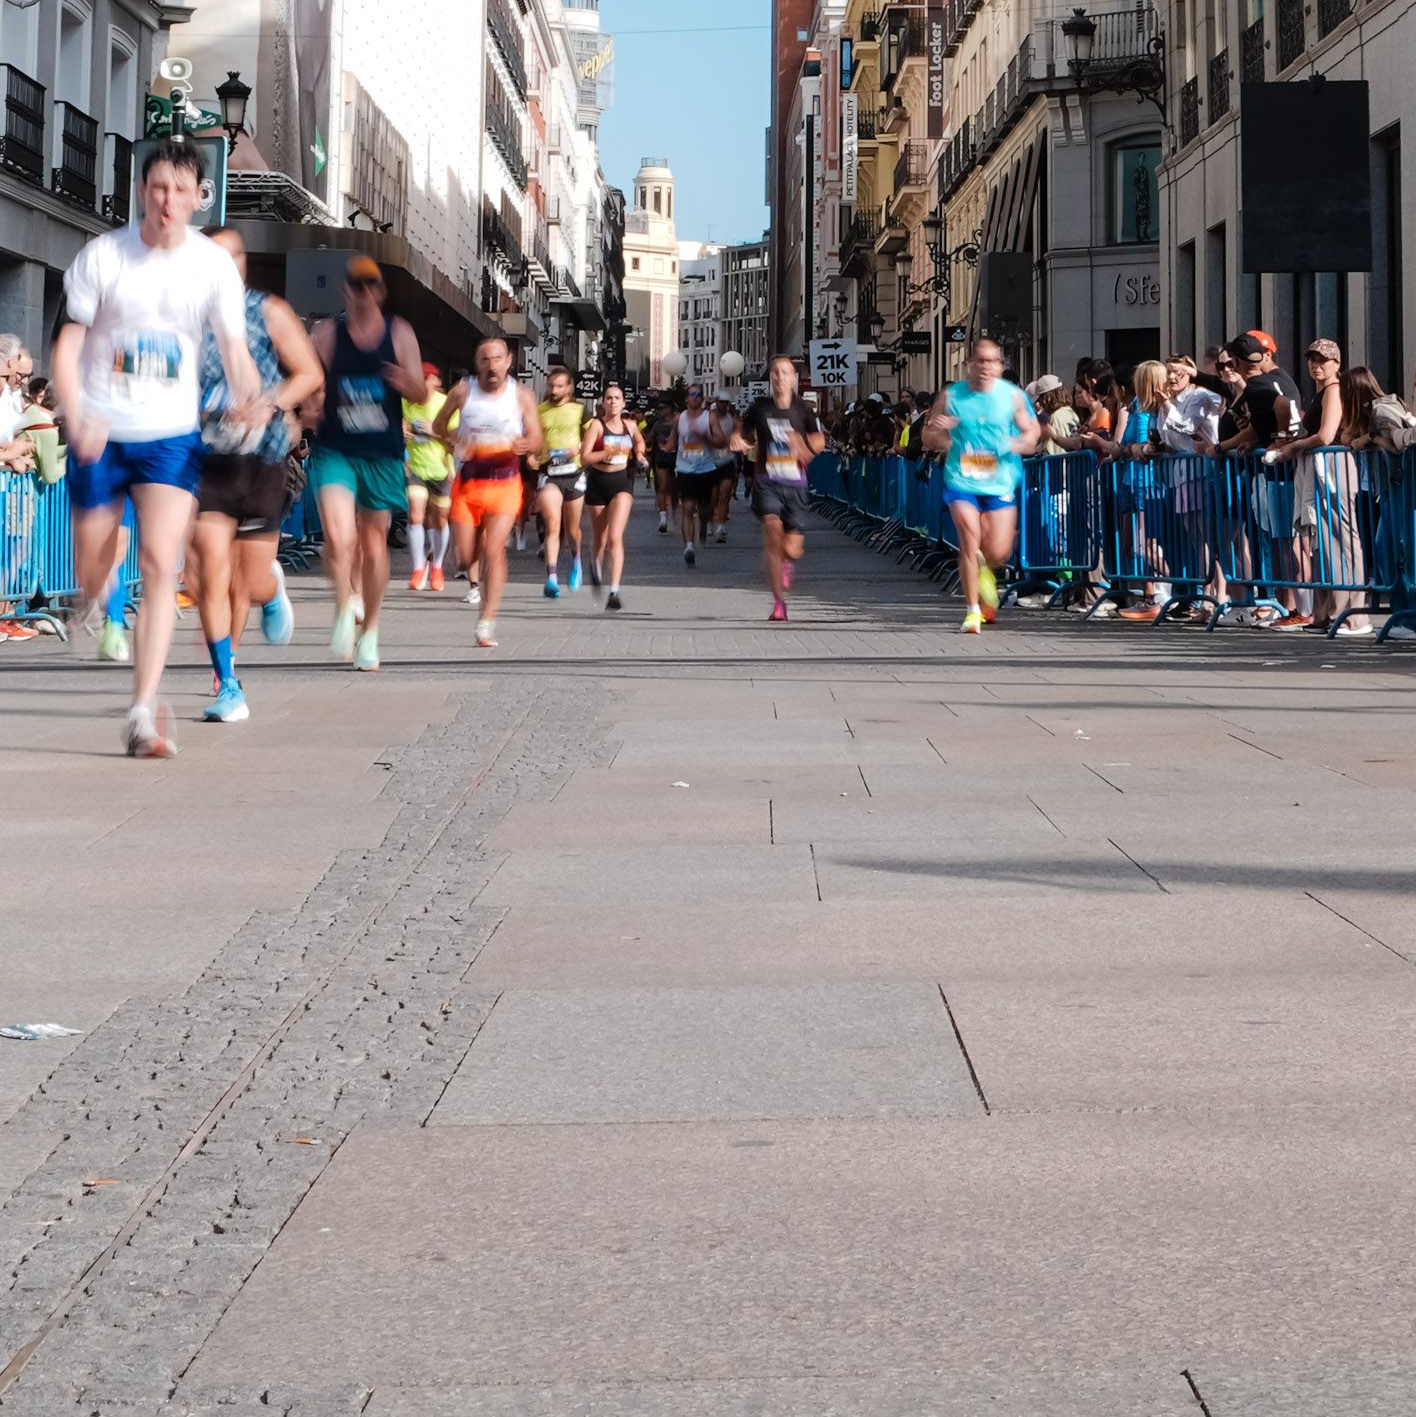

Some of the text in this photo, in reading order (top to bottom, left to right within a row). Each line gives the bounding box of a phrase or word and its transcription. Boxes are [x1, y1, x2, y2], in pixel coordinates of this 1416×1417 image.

[929, 22, 942, 71] Locker
[846, 98, 854, 137] HOTELITY
[1125, 274, 1160, 304] Sfe
[817, 354, 849, 370] 21K
[576, 380, 599, 391] 42K
[821, 372, 846, 384] 10K
[751, 388, 767, 396] 21K
